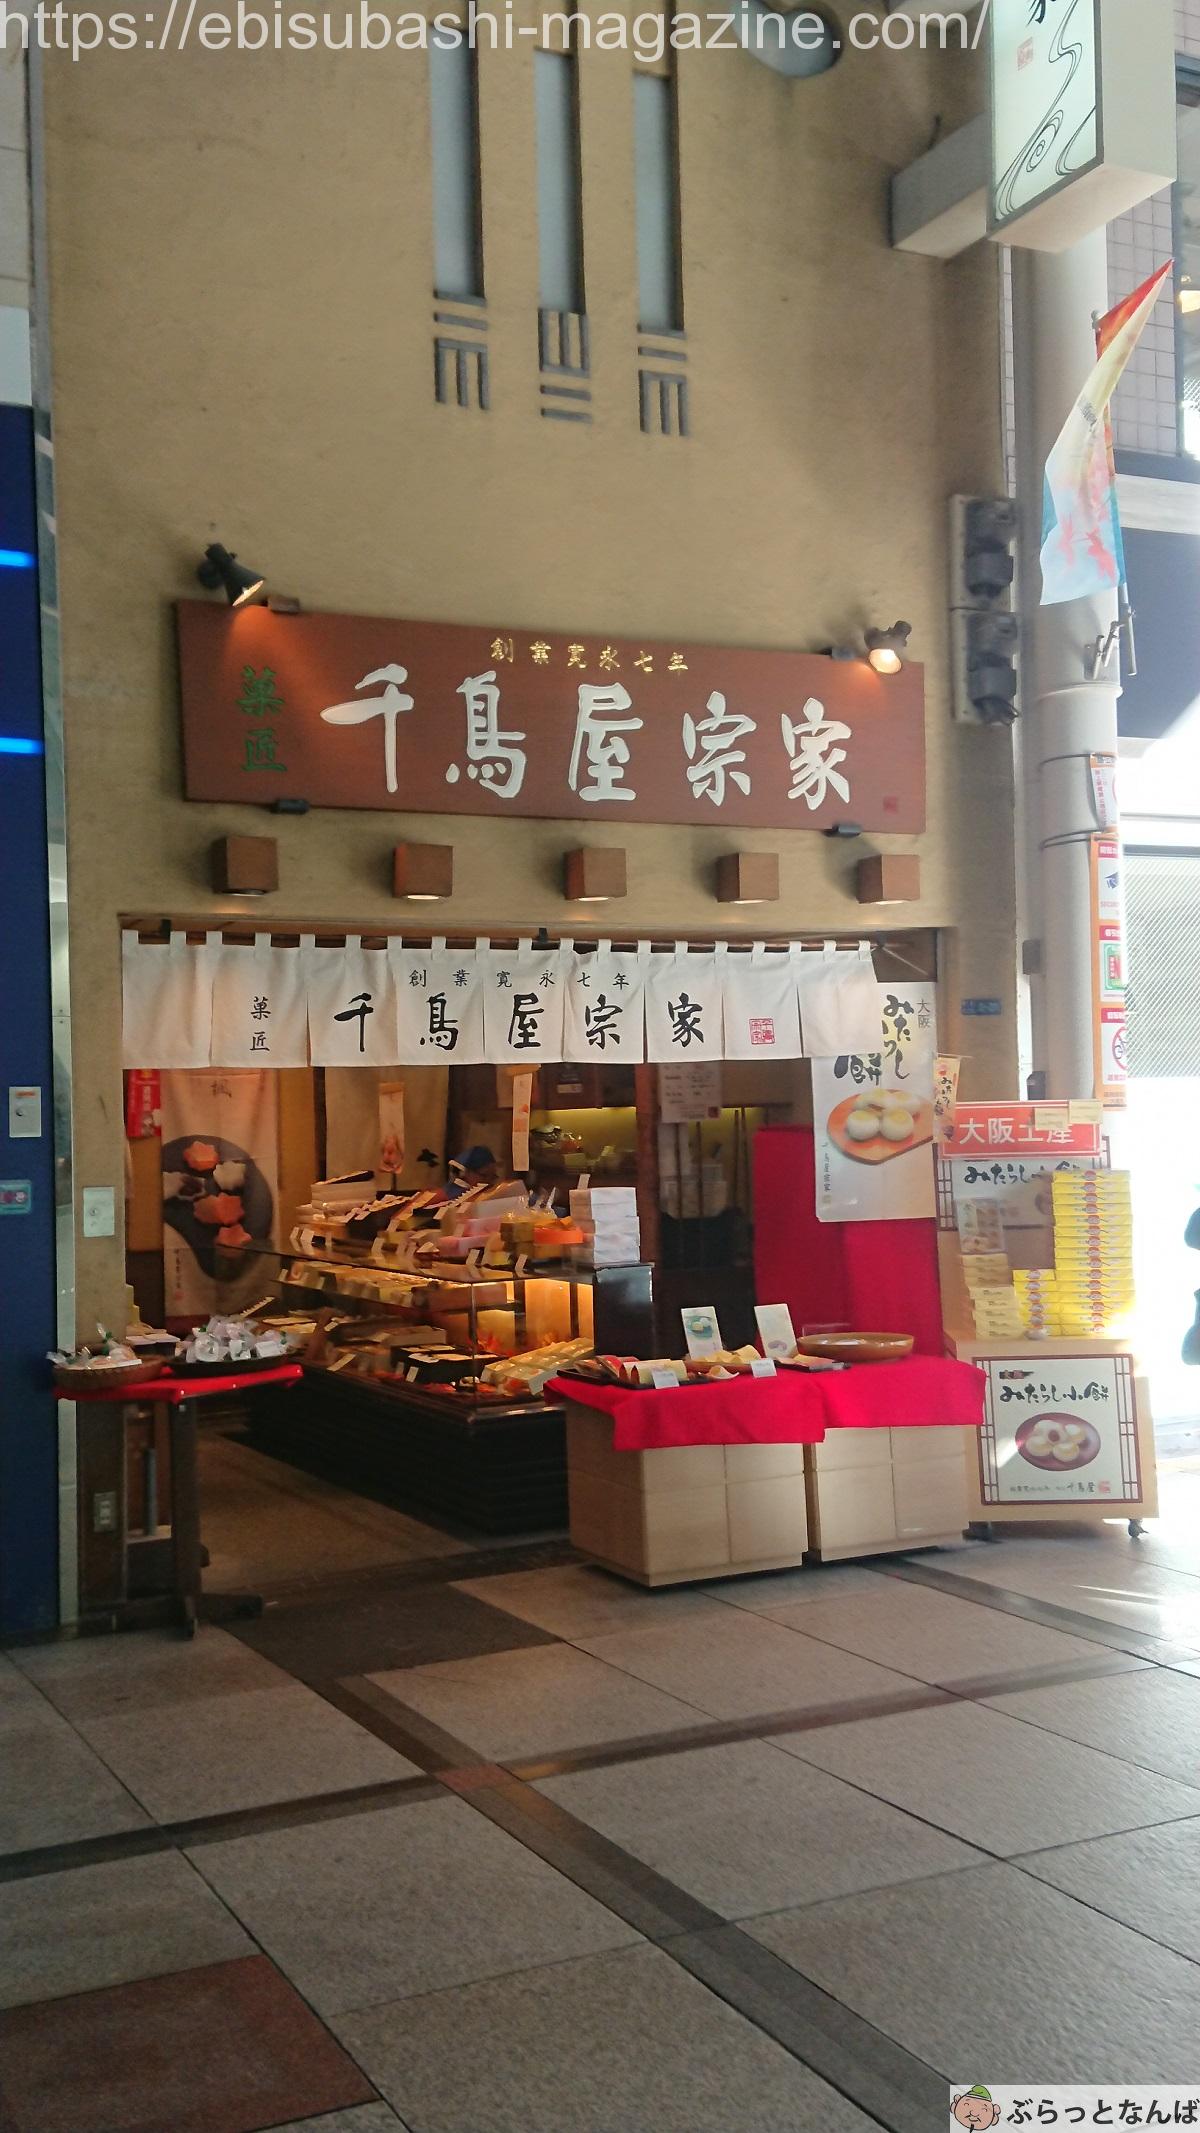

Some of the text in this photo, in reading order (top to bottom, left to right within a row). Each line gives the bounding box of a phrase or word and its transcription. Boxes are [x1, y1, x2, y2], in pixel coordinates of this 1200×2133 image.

[490, 637, 689, 673] 創業寛永七年
[235, 664, 288, 773] 菓匠
[320, 663, 852, 811] 千鳥屋宗家
[408, 969, 630, 991] 創業寛永七年
[249, 995, 272, 1053] 菓匠
[333, 992, 705, 1053] 千鳥屋宗家
[916, 998, 932, 1029] 大阪
[1000, 1381, 1110, 1404] みたらし小餅
